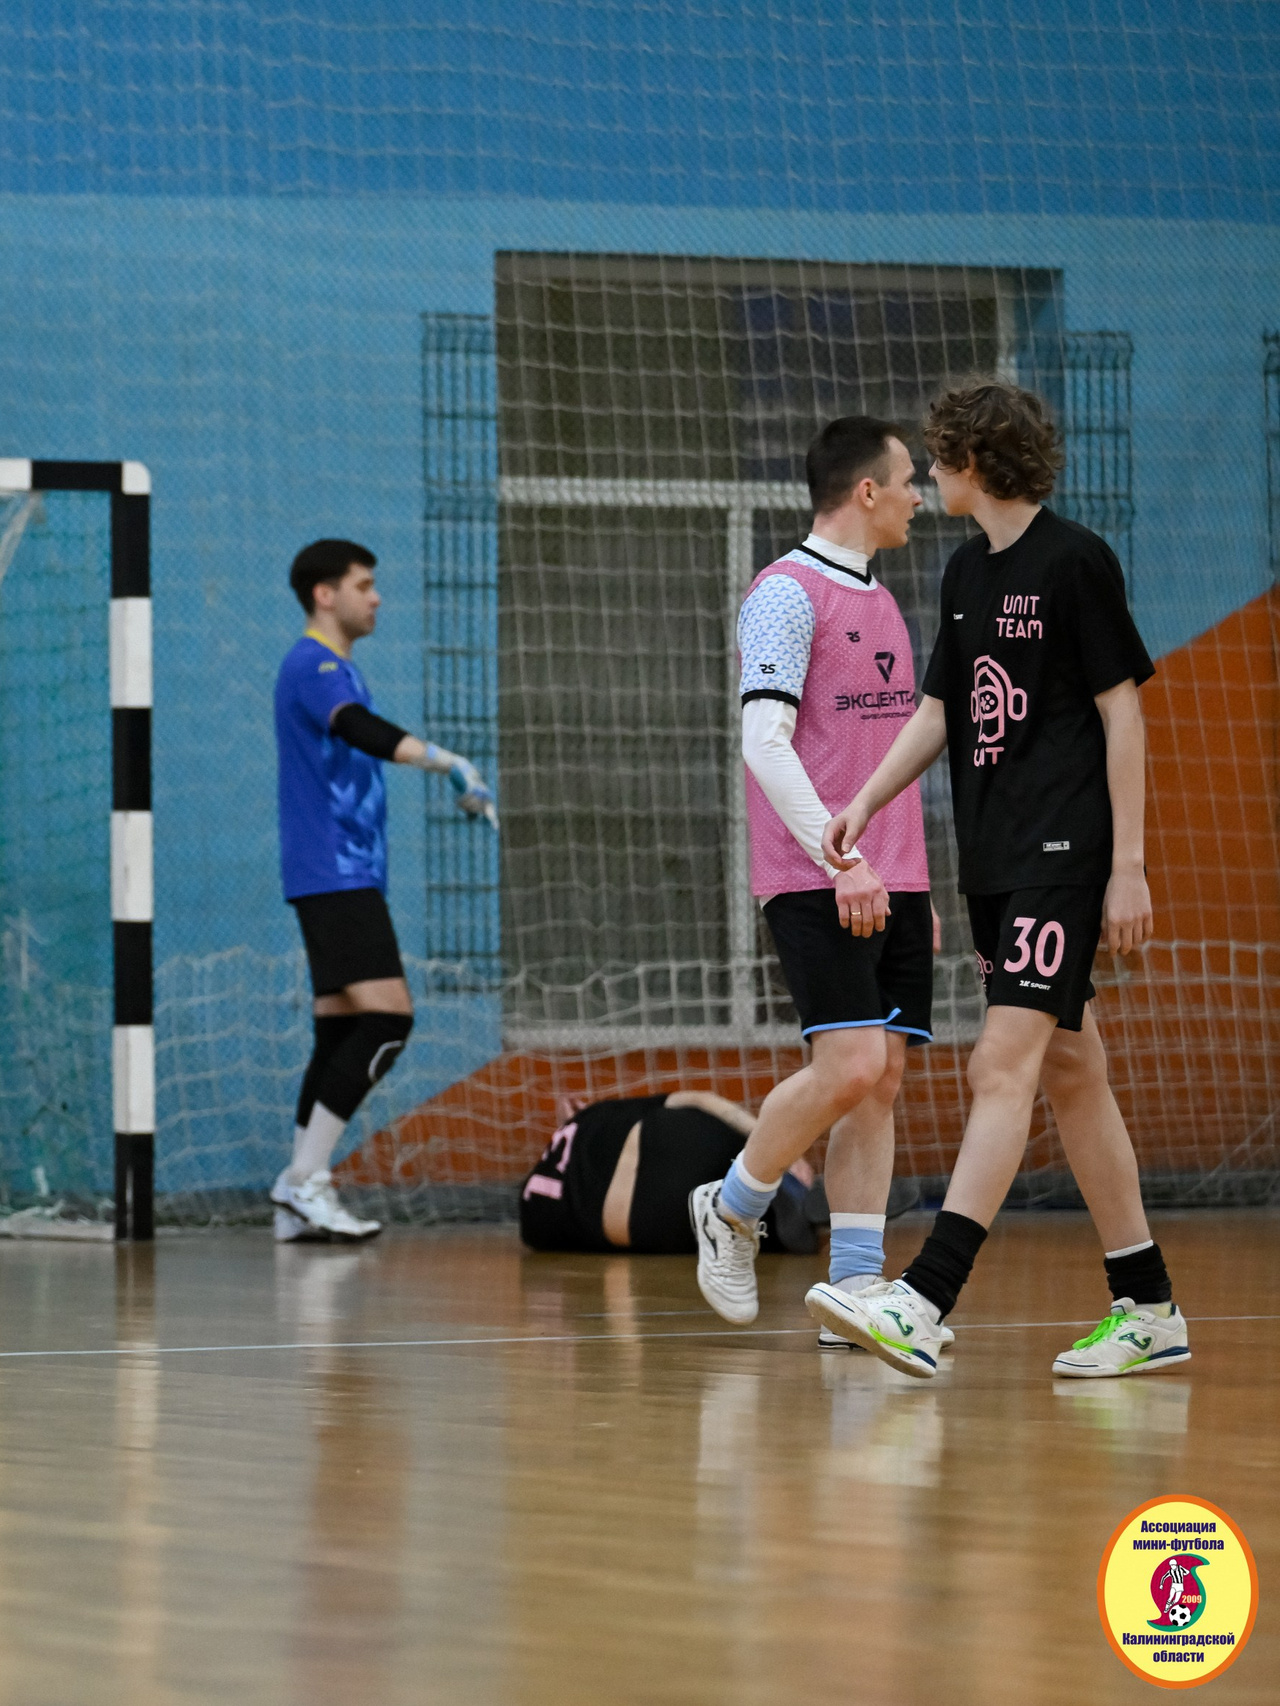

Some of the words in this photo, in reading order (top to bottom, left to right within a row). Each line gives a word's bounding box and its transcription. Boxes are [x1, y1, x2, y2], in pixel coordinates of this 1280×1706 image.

[1003, 595, 1040, 616] UNIT
[996, 618, 1043, 640] TEAM
[1003, 917, 1066, 978] 30
[1030, 982, 1051, 990] SPORT
